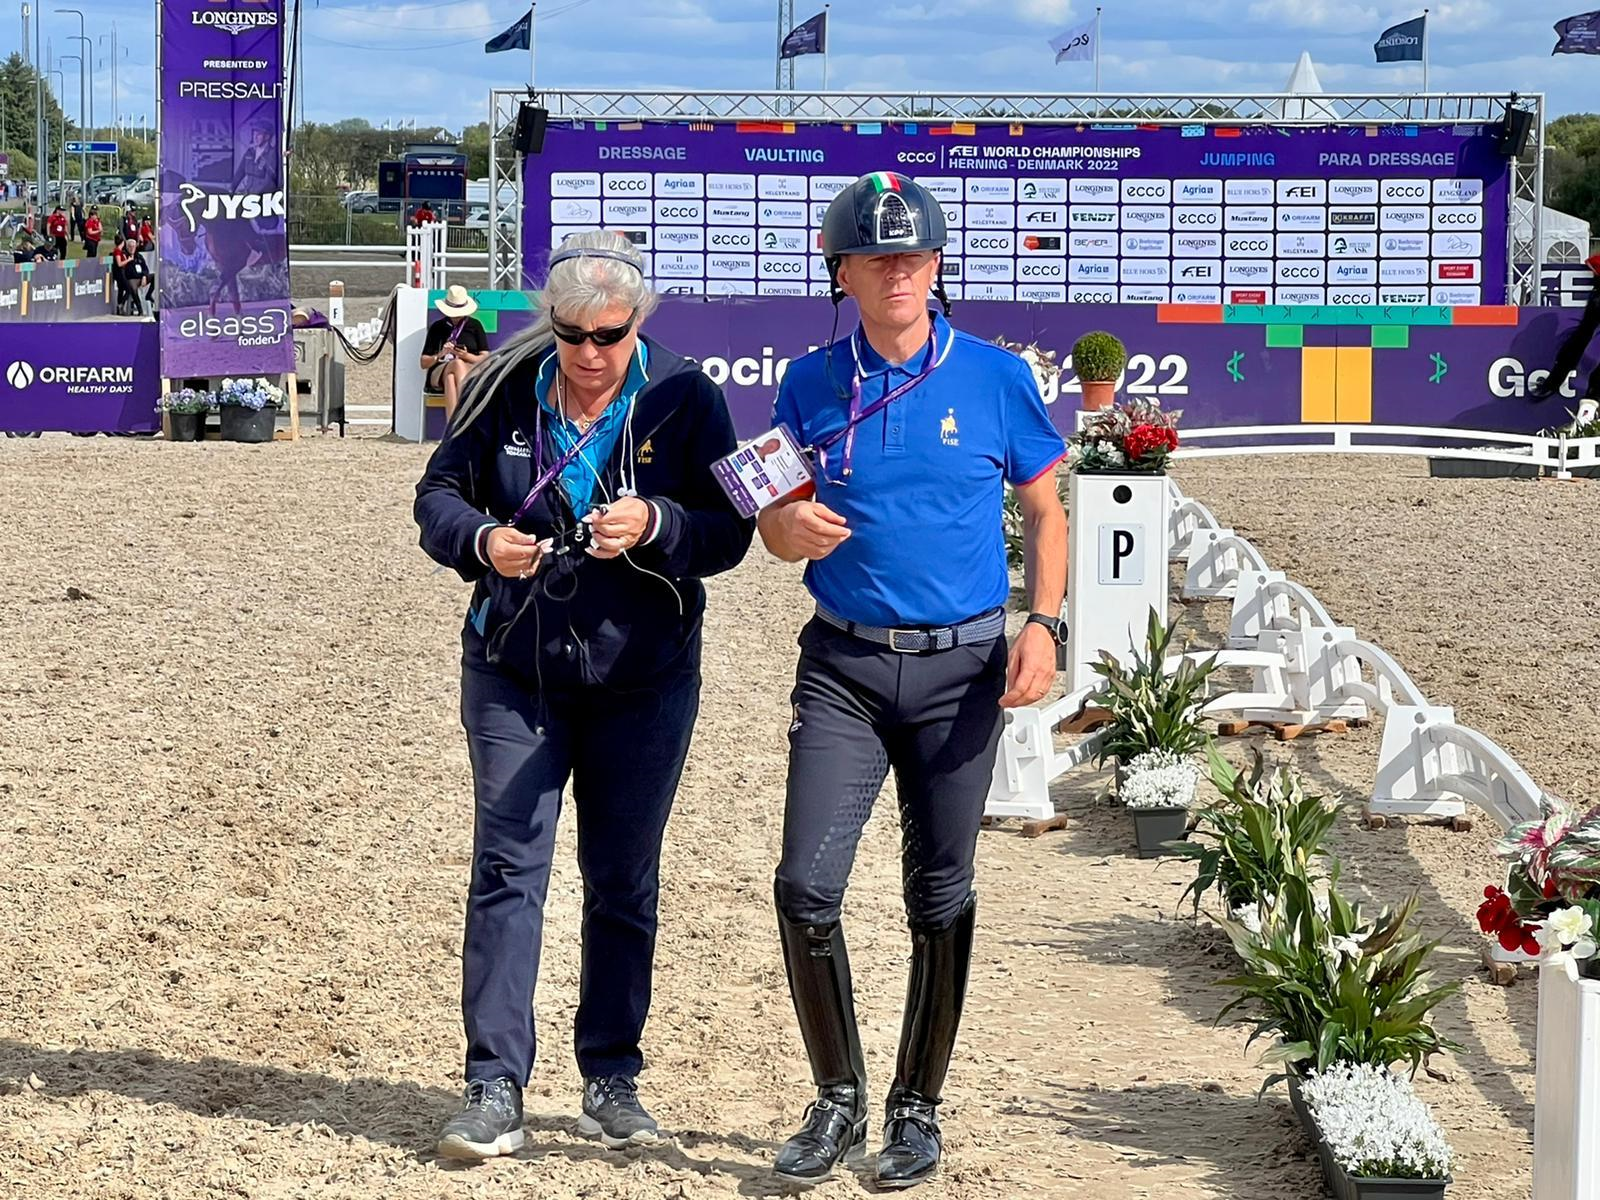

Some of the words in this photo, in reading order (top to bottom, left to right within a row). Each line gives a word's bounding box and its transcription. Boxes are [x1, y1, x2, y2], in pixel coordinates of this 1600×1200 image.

[192, 11, 278, 25] LONGINES
[204, 60, 254, 68] PRESENTED
[599, 146, 686, 160] DRESSAGE
[744, 148, 824, 162] VAULTING
[983, 146, 1033, 158] WORLD
[1034, 146, 1141, 158] CHAMPIONSHIPS
[898, 152, 936, 164] ecco
[1200, 152, 1275, 166] JUMPING
[1319, 153, 1362, 166] PARA
[1368, 152, 1455, 166] DRESSAGE
[950, 158, 1008, 170] HERNING
[1018, 160, 1083, 170] DENMARK
[1087, 160, 1118, 171] 2022
[608, 180, 646, 190] ecco
[664, 179, 688, 190] Agria
[1127, 186, 1165, 197] ecco
[1182, 185, 1206, 196] Agria
[1386, 187, 1424, 197] ecco
[202, 192, 284, 220] JYSK
[660, 207, 698, 218] ecco
[712, 209, 750, 217] Mustang
[1072, 213, 1116, 222] FENDT
[1178, 214, 1216, 224] ecco
[1438, 214, 1476, 224] ecco
[712, 234, 750, 246] ecco
[970, 238, 1008, 248] ecco
[1230, 240, 1268, 251] ecco
[764, 262, 802, 272] ecco
[1022, 266, 1060, 276] ecco
[1078, 264, 1102, 274] Agria
[1337, 265, 1360, 276] Agria
[1281, 268, 1320, 278] ecco
[1074, 292, 1112, 304] ecco
[1333, 294, 1371, 304] ecco
[1382, 294, 1426, 302] FENDT
[180, 311, 275, 337] elsass
[238, 335, 275, 346] fonden
[40, 367, 132, 383] ORIFARM
[68, 386, 106, 394] HEALTHY
[1113, 530, 1134, 578] P
